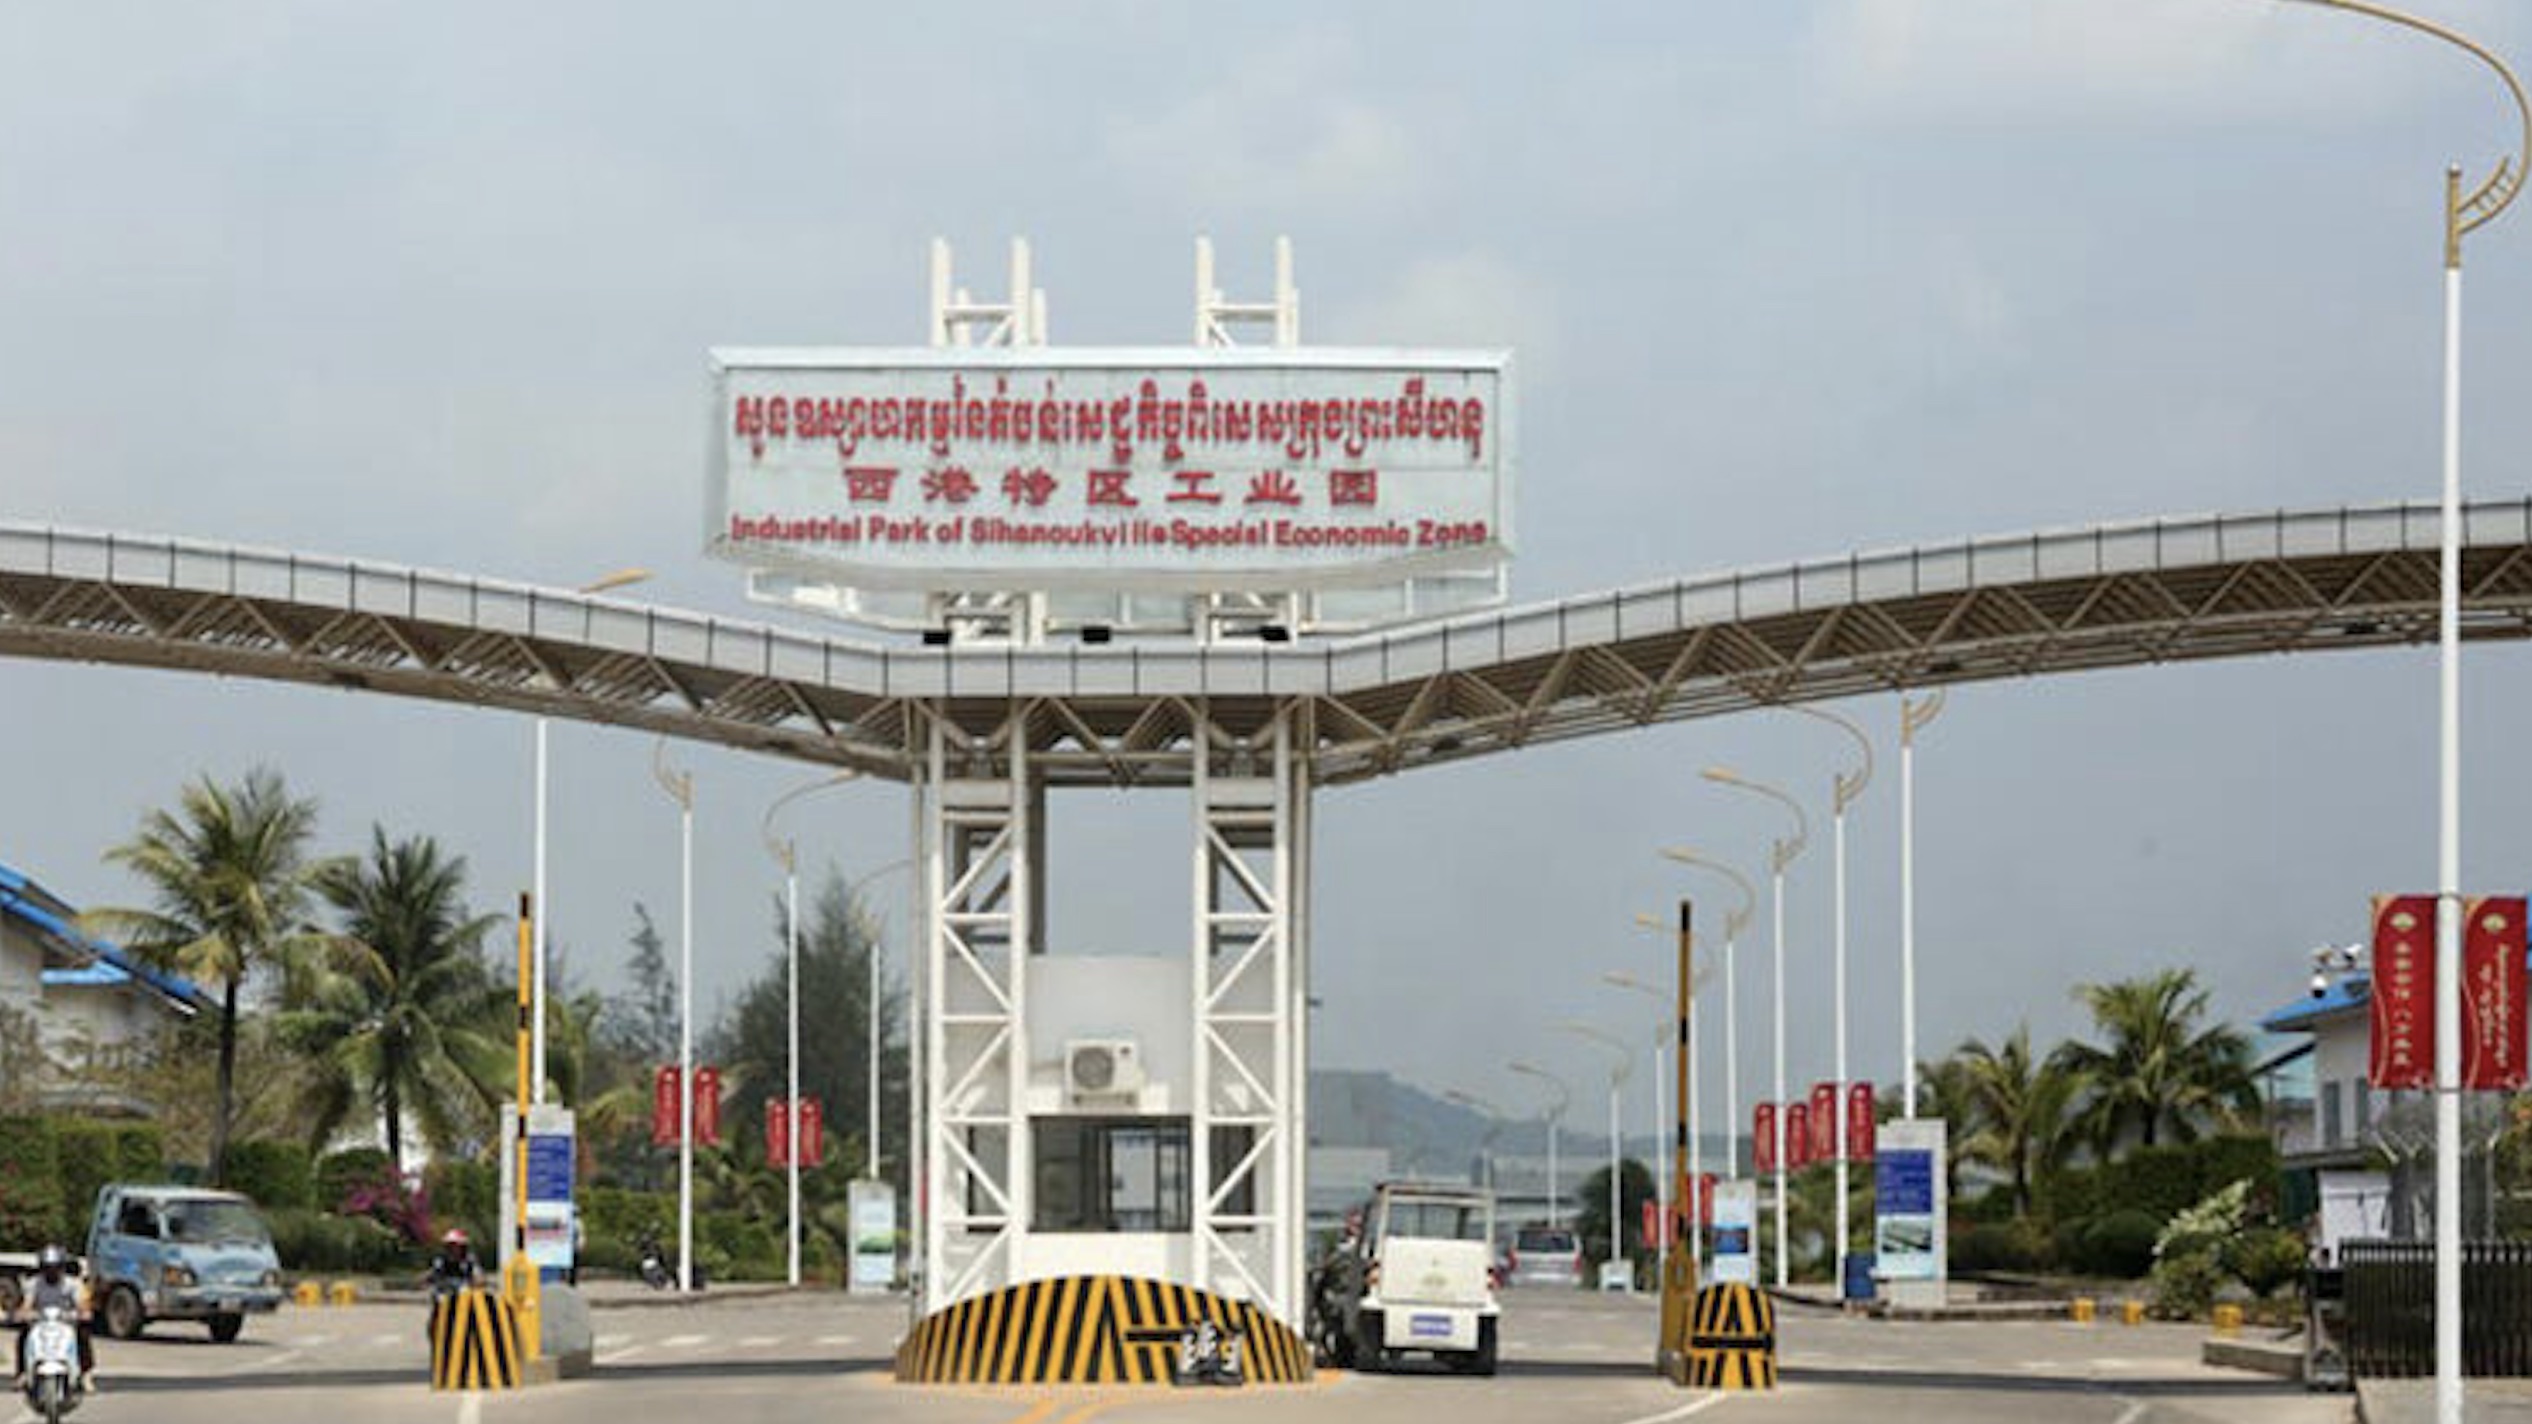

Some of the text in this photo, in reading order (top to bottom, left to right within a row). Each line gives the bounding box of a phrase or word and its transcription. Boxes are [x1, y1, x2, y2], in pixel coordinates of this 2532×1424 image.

[844, 466, 1378, 507] 西港特区工业园
[731, 516, 863, 542] Industrial
[869, 516, 927, 542] Park
[937, 516, 963, 542] of
[1275, 519, 1410, 547] Economic
[1416, 519, 1487, 546] Zone
